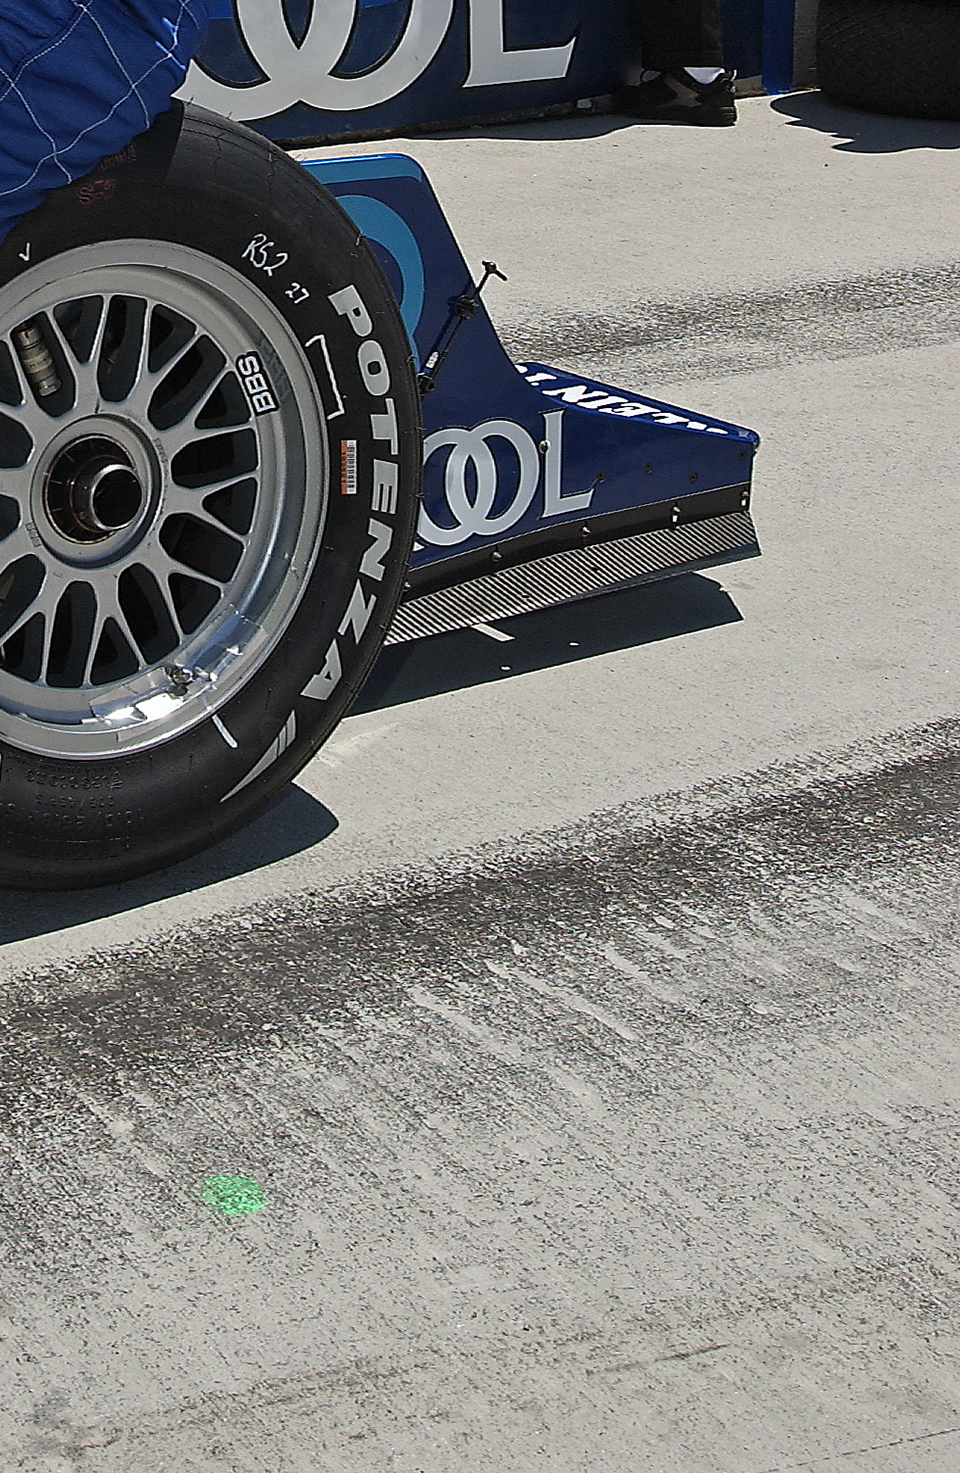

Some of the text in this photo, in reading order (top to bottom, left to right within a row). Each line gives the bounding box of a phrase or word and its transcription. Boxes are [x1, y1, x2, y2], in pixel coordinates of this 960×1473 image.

[285, 282, 310, 304] 27
[238, 354, 276, 414] BBS
[301, 283, 399, 701] POTENZA
[415, 409, 602, 546] OOL
